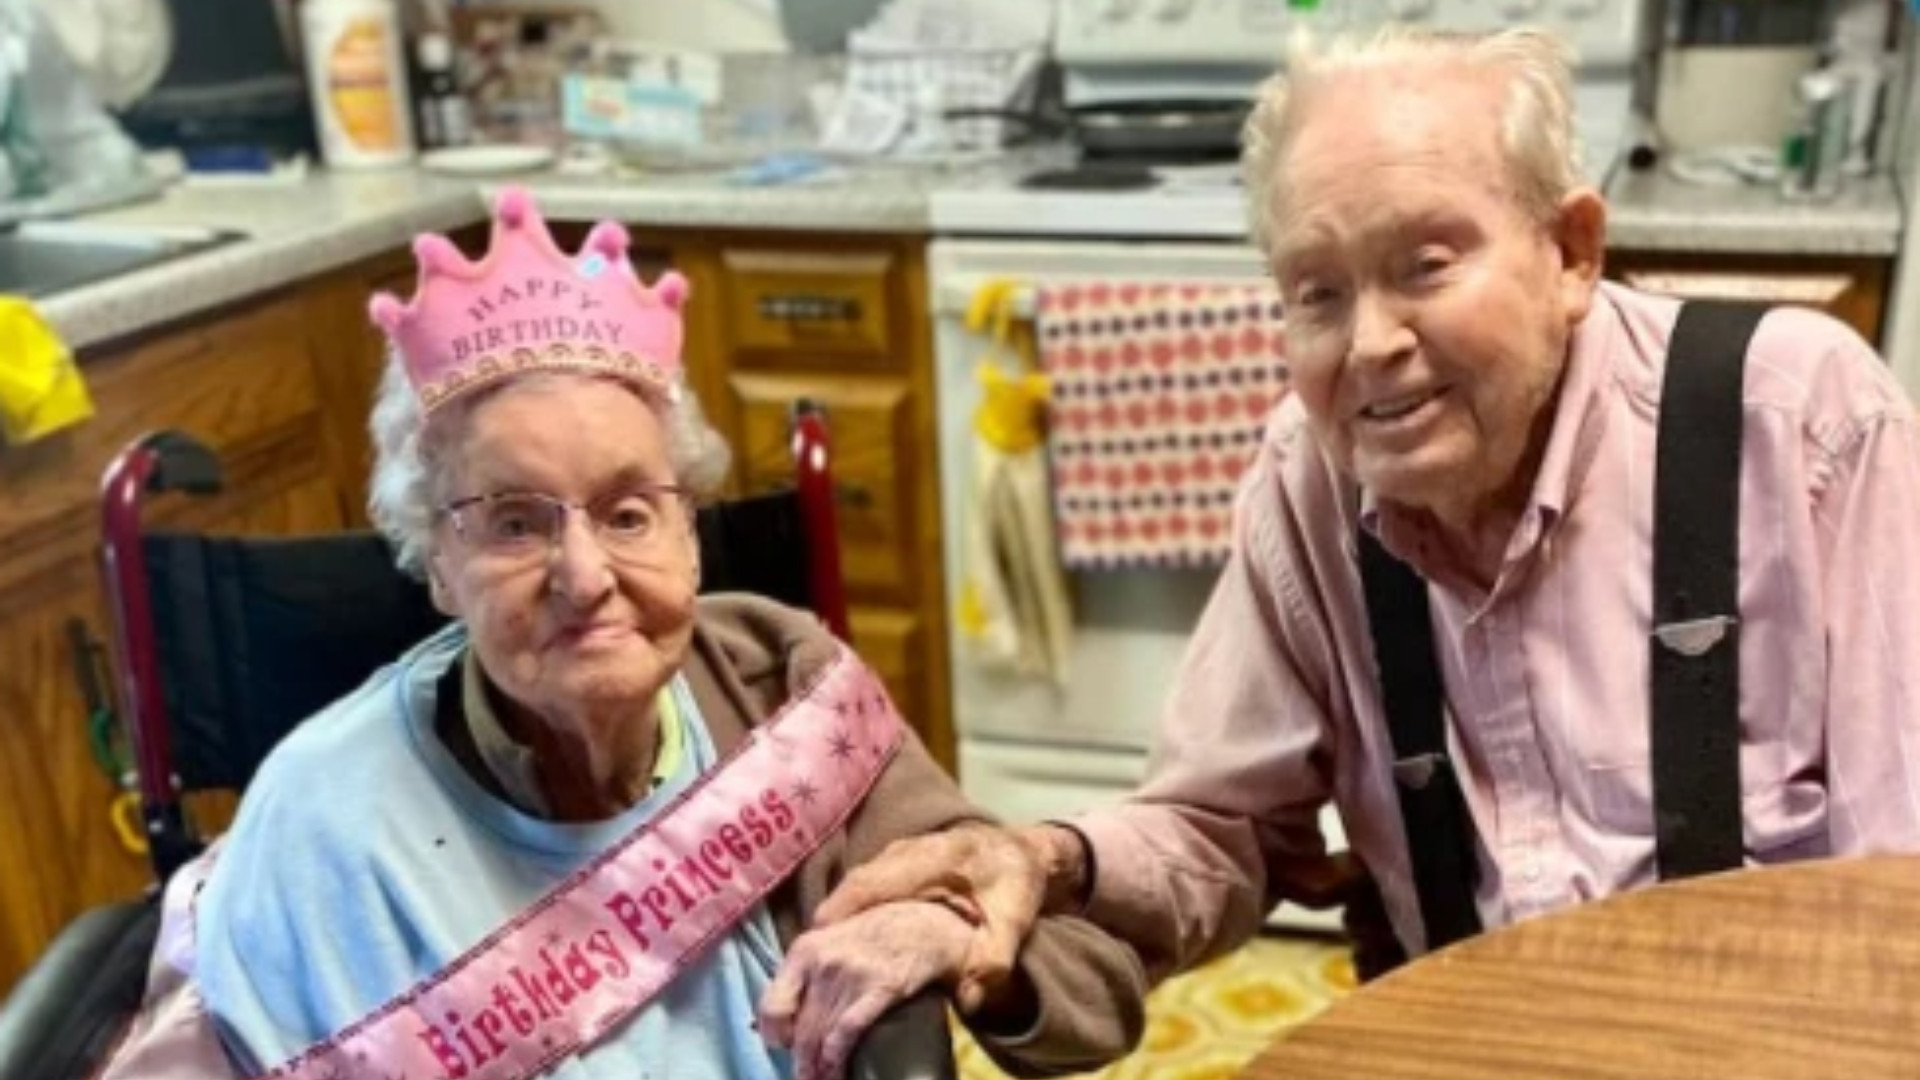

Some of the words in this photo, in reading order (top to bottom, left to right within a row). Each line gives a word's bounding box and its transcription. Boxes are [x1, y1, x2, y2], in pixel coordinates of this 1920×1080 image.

[469, 279, 601, 322] HAPPY
[452, 316, 624, 360] BIRTHDAY
[417, 928, 630, 1079] Birthday
[606, 789, 795, 951] Princess
